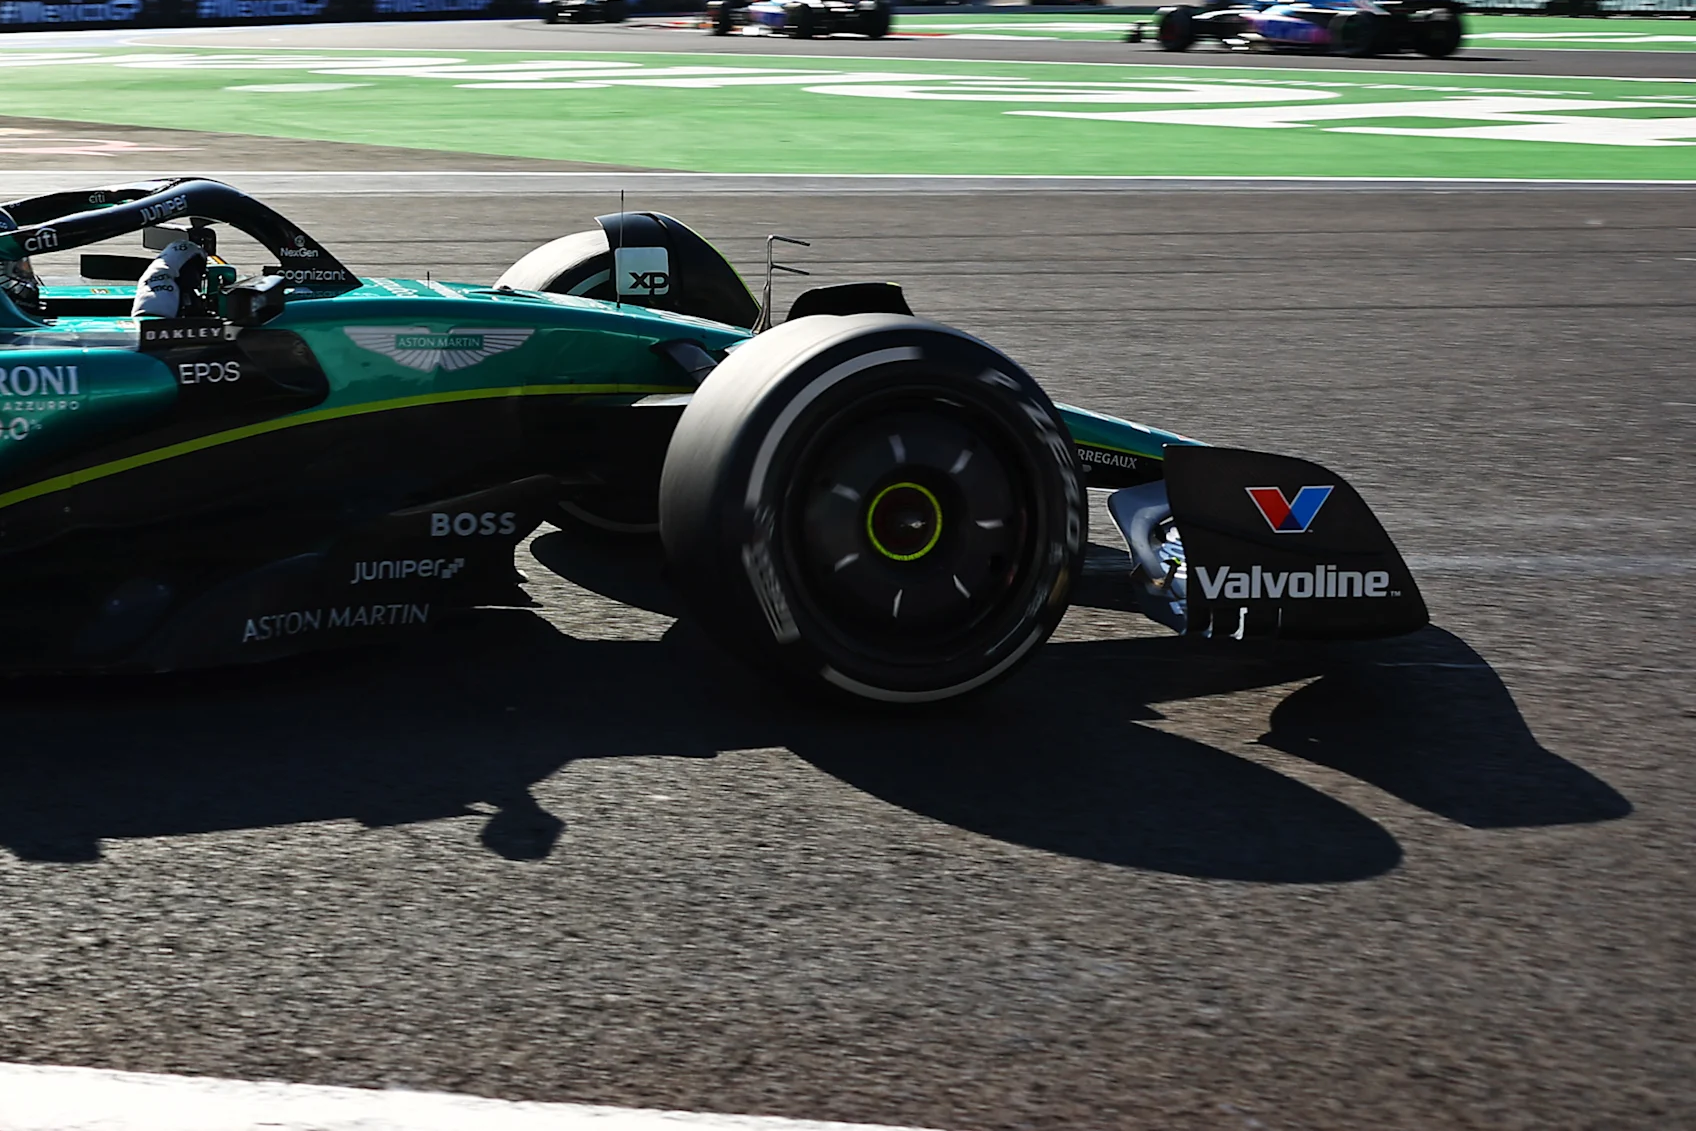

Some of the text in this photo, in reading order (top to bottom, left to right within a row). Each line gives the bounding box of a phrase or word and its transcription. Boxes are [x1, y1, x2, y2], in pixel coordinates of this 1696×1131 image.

[24, 227, 59, 251] citi
[280, 248, 319, 258] NexGen
[276, 268, 346, 284] cognizant
[145, 327, 221, 340] OAKLEY
[398, 337, 480, 347] ASTON MARTIN
[3, 400, 81, 411] AZZURRO
[431, 512, 516, 536] BOSS
[1195, 564, 1390, 599] Valvoline
[242, 603, 430, 643] ASTON MARTIN
